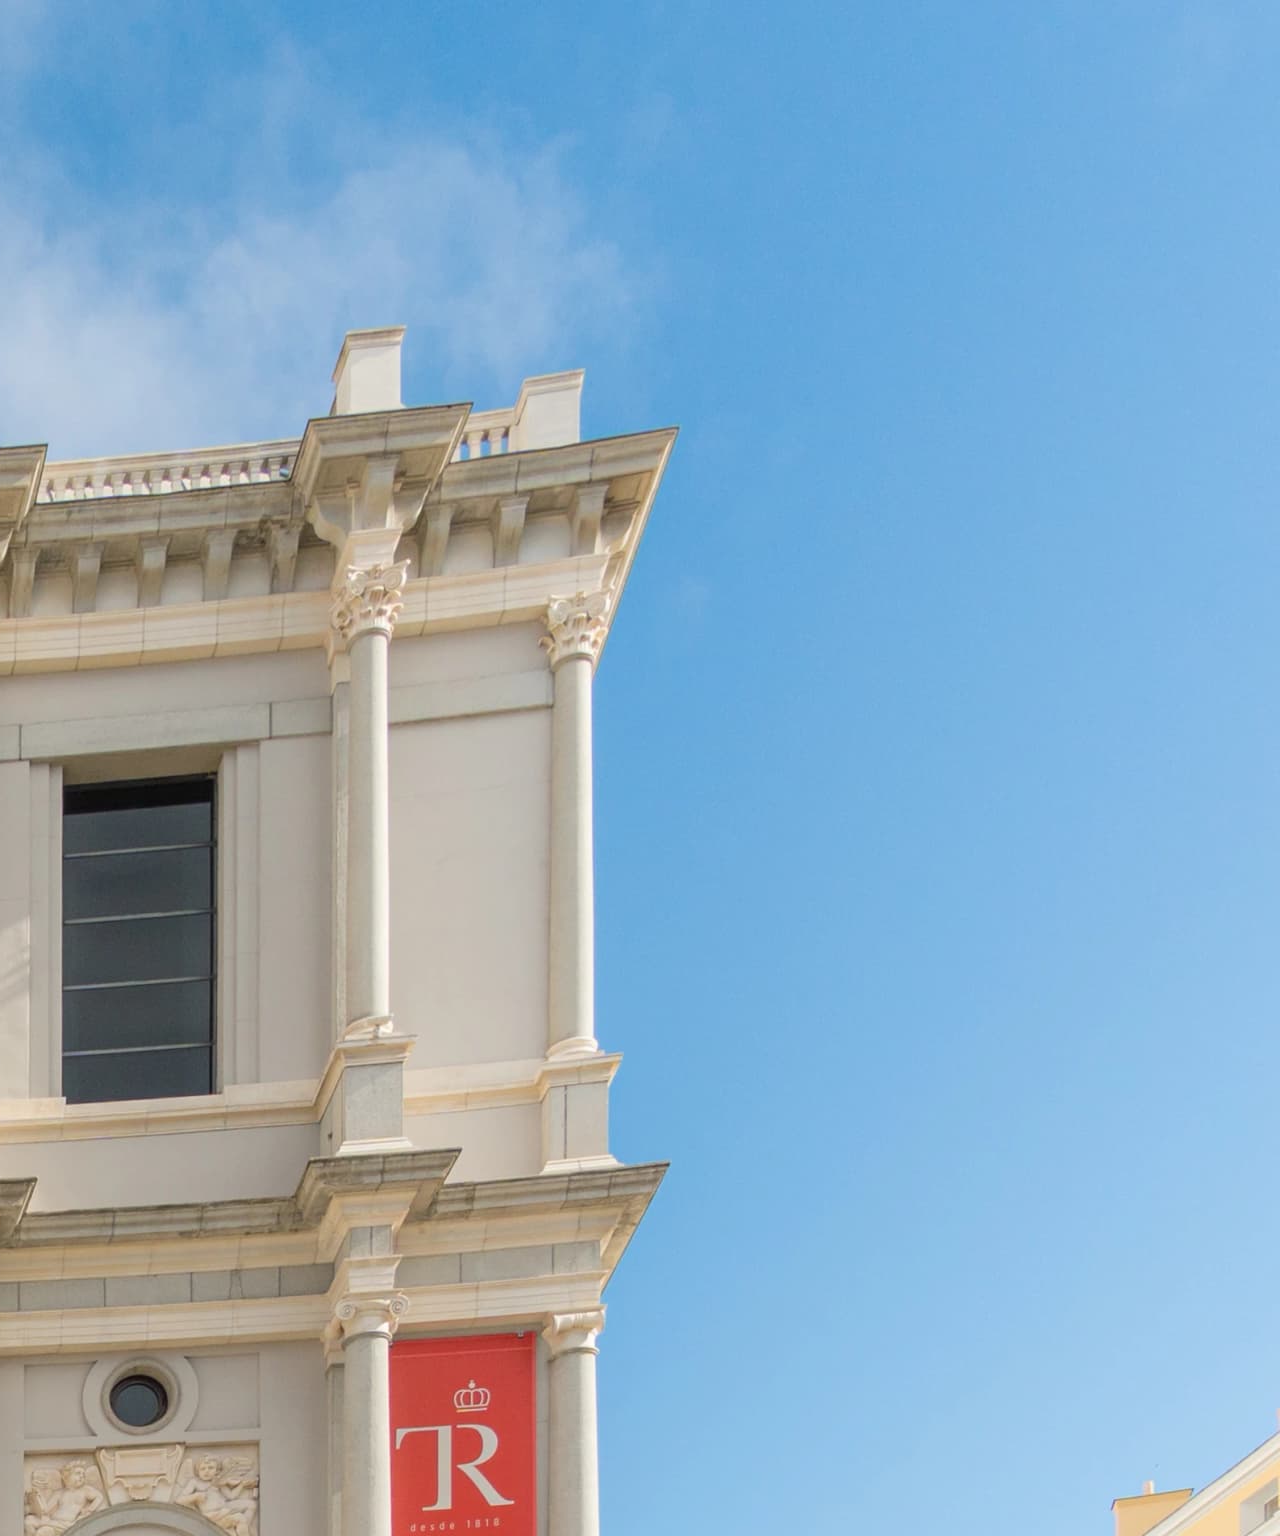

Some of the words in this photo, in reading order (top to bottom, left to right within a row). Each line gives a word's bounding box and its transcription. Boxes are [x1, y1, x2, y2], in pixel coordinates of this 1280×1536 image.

[395, 1424, 515, 1512] TR
[410, 1521, 456, 1533] desde
[466, 1517, 500, 1529] 1818
